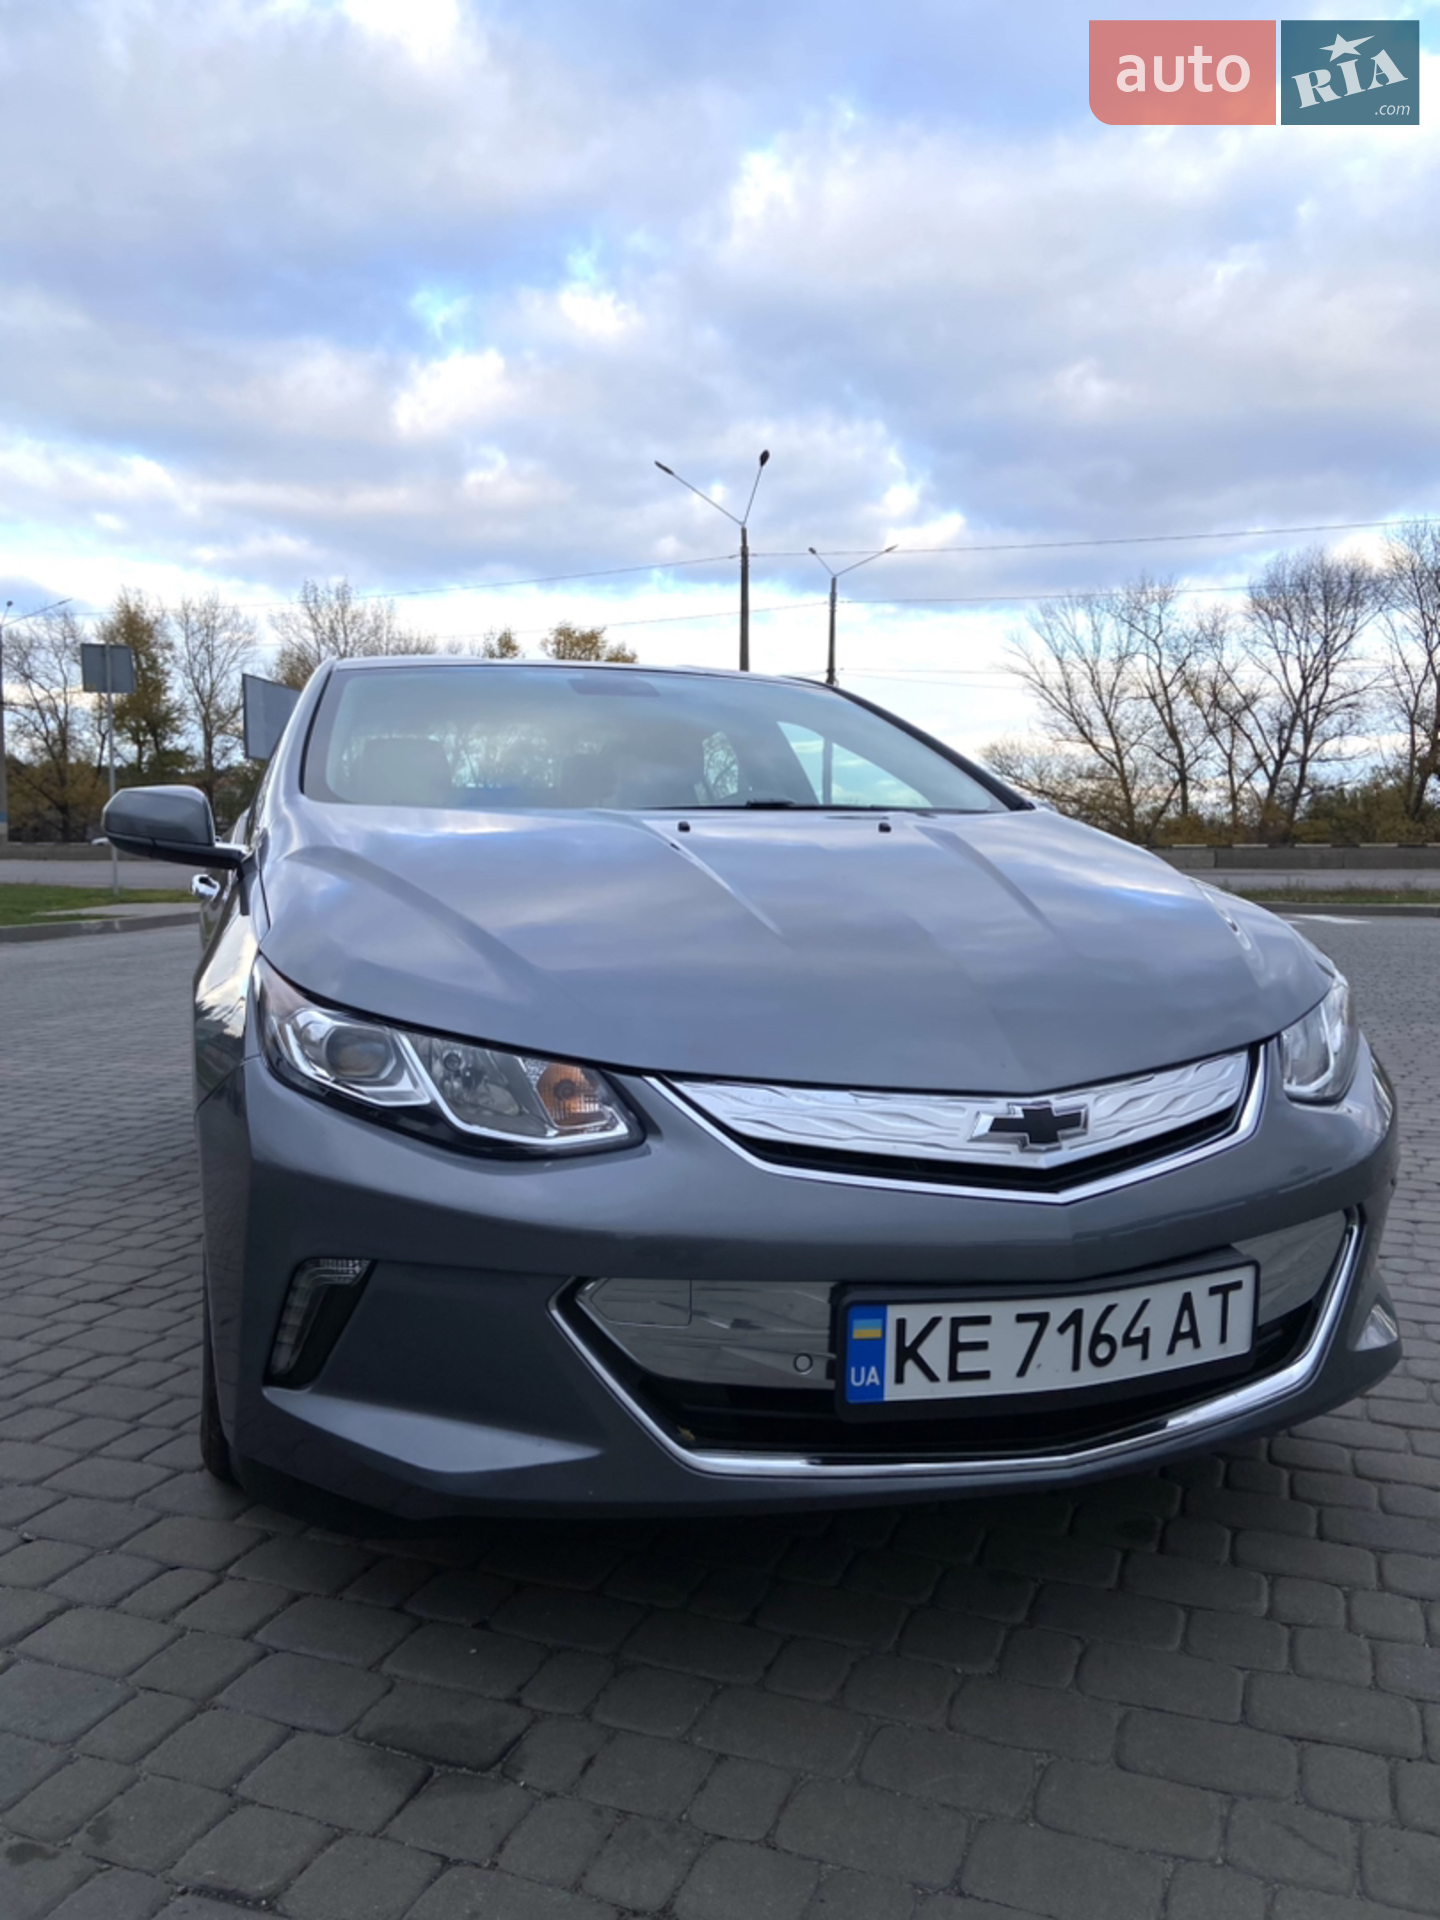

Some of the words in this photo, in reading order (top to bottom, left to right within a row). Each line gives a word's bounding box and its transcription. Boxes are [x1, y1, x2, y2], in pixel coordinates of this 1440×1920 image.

[893, 1315, 992, 1386] KE
[1015, 1298, 1151, 1379] 7164
[1166, 1279, 1244, 1356] AT
[849, 1366, 880, 1387] UA
